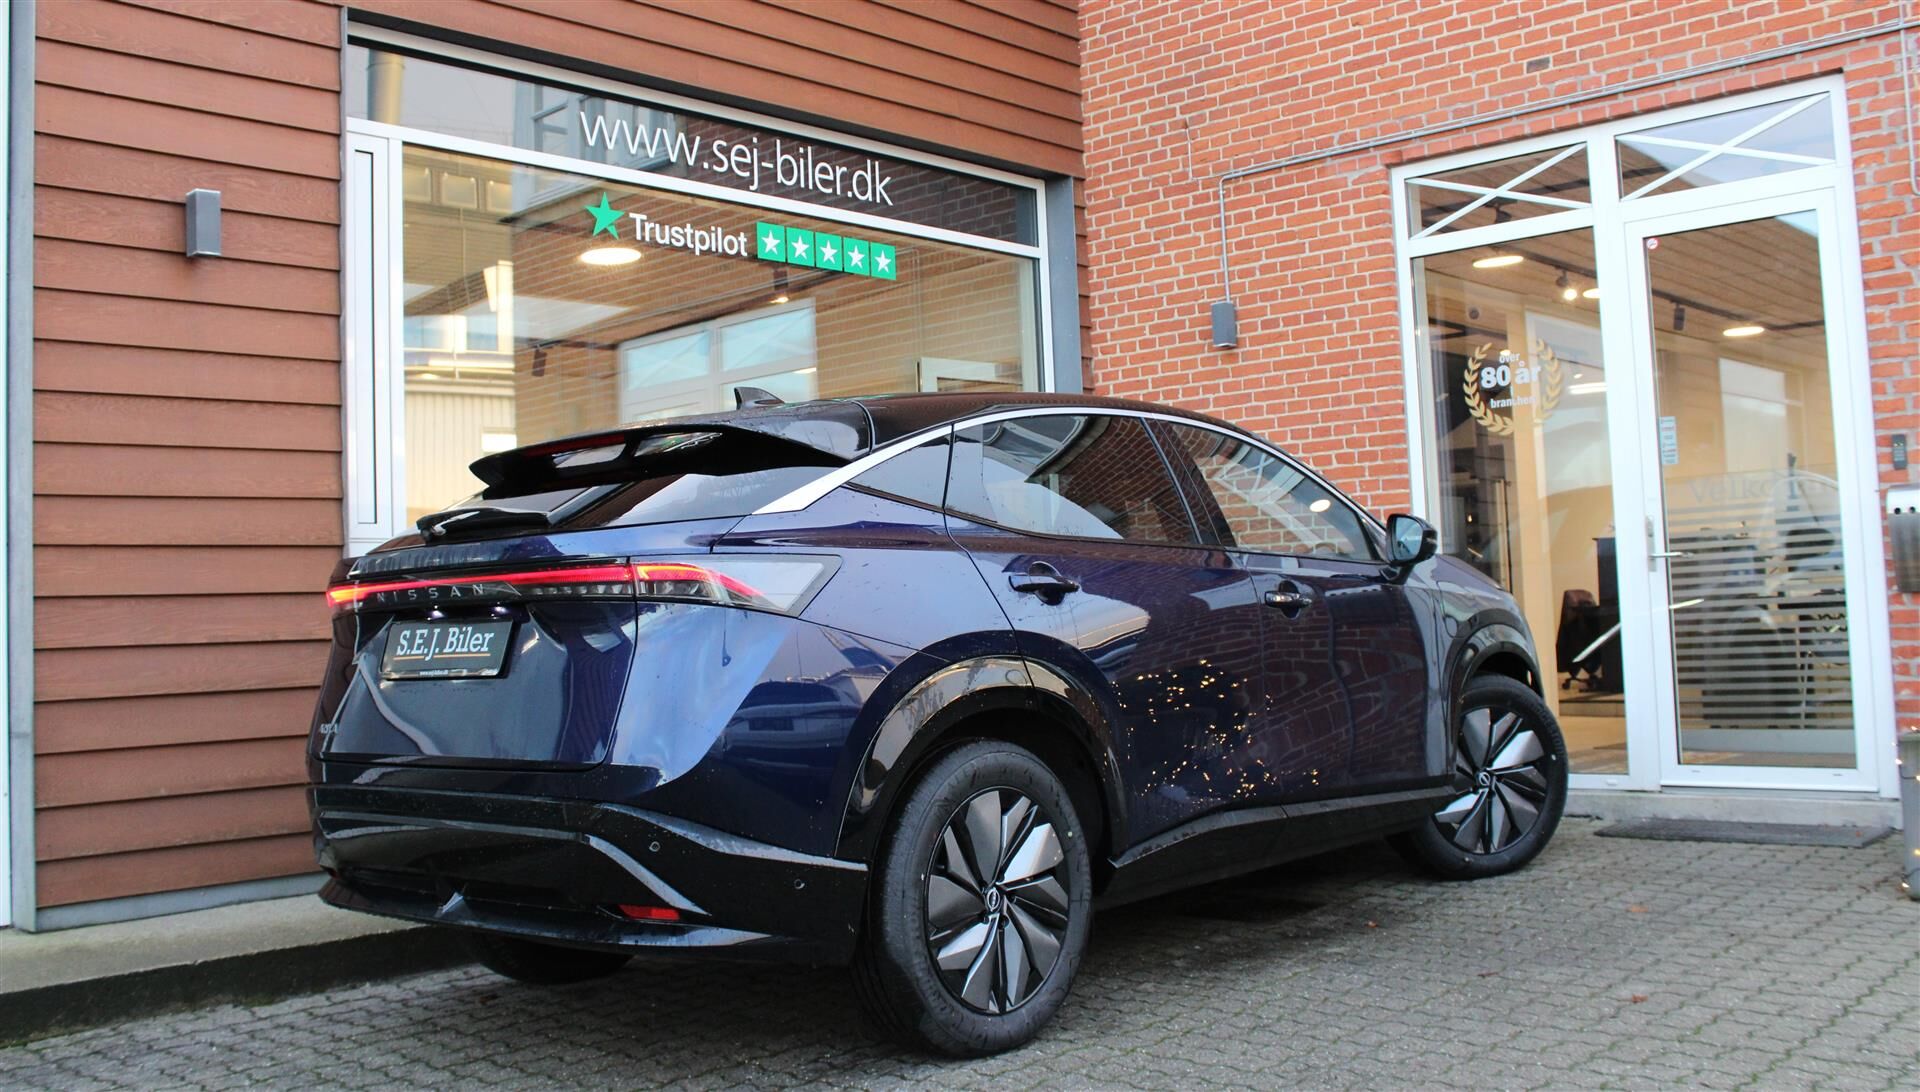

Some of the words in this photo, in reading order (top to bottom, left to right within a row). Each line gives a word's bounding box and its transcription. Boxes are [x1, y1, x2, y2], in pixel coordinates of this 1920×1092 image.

[580, 111, 893, 206] www.sej-biler.dk
[629, 212, 748, 257] Trustpilot
[1499, 353, 1520, 363] over
[1481, 366, 1511, 388] 80
[1515, 361, 1541, 384] år
[377, 584, 484, 602] NISSAN
[396, 628, 441, 661] S.E.J.
[443, 626, 495, 653] Biler
